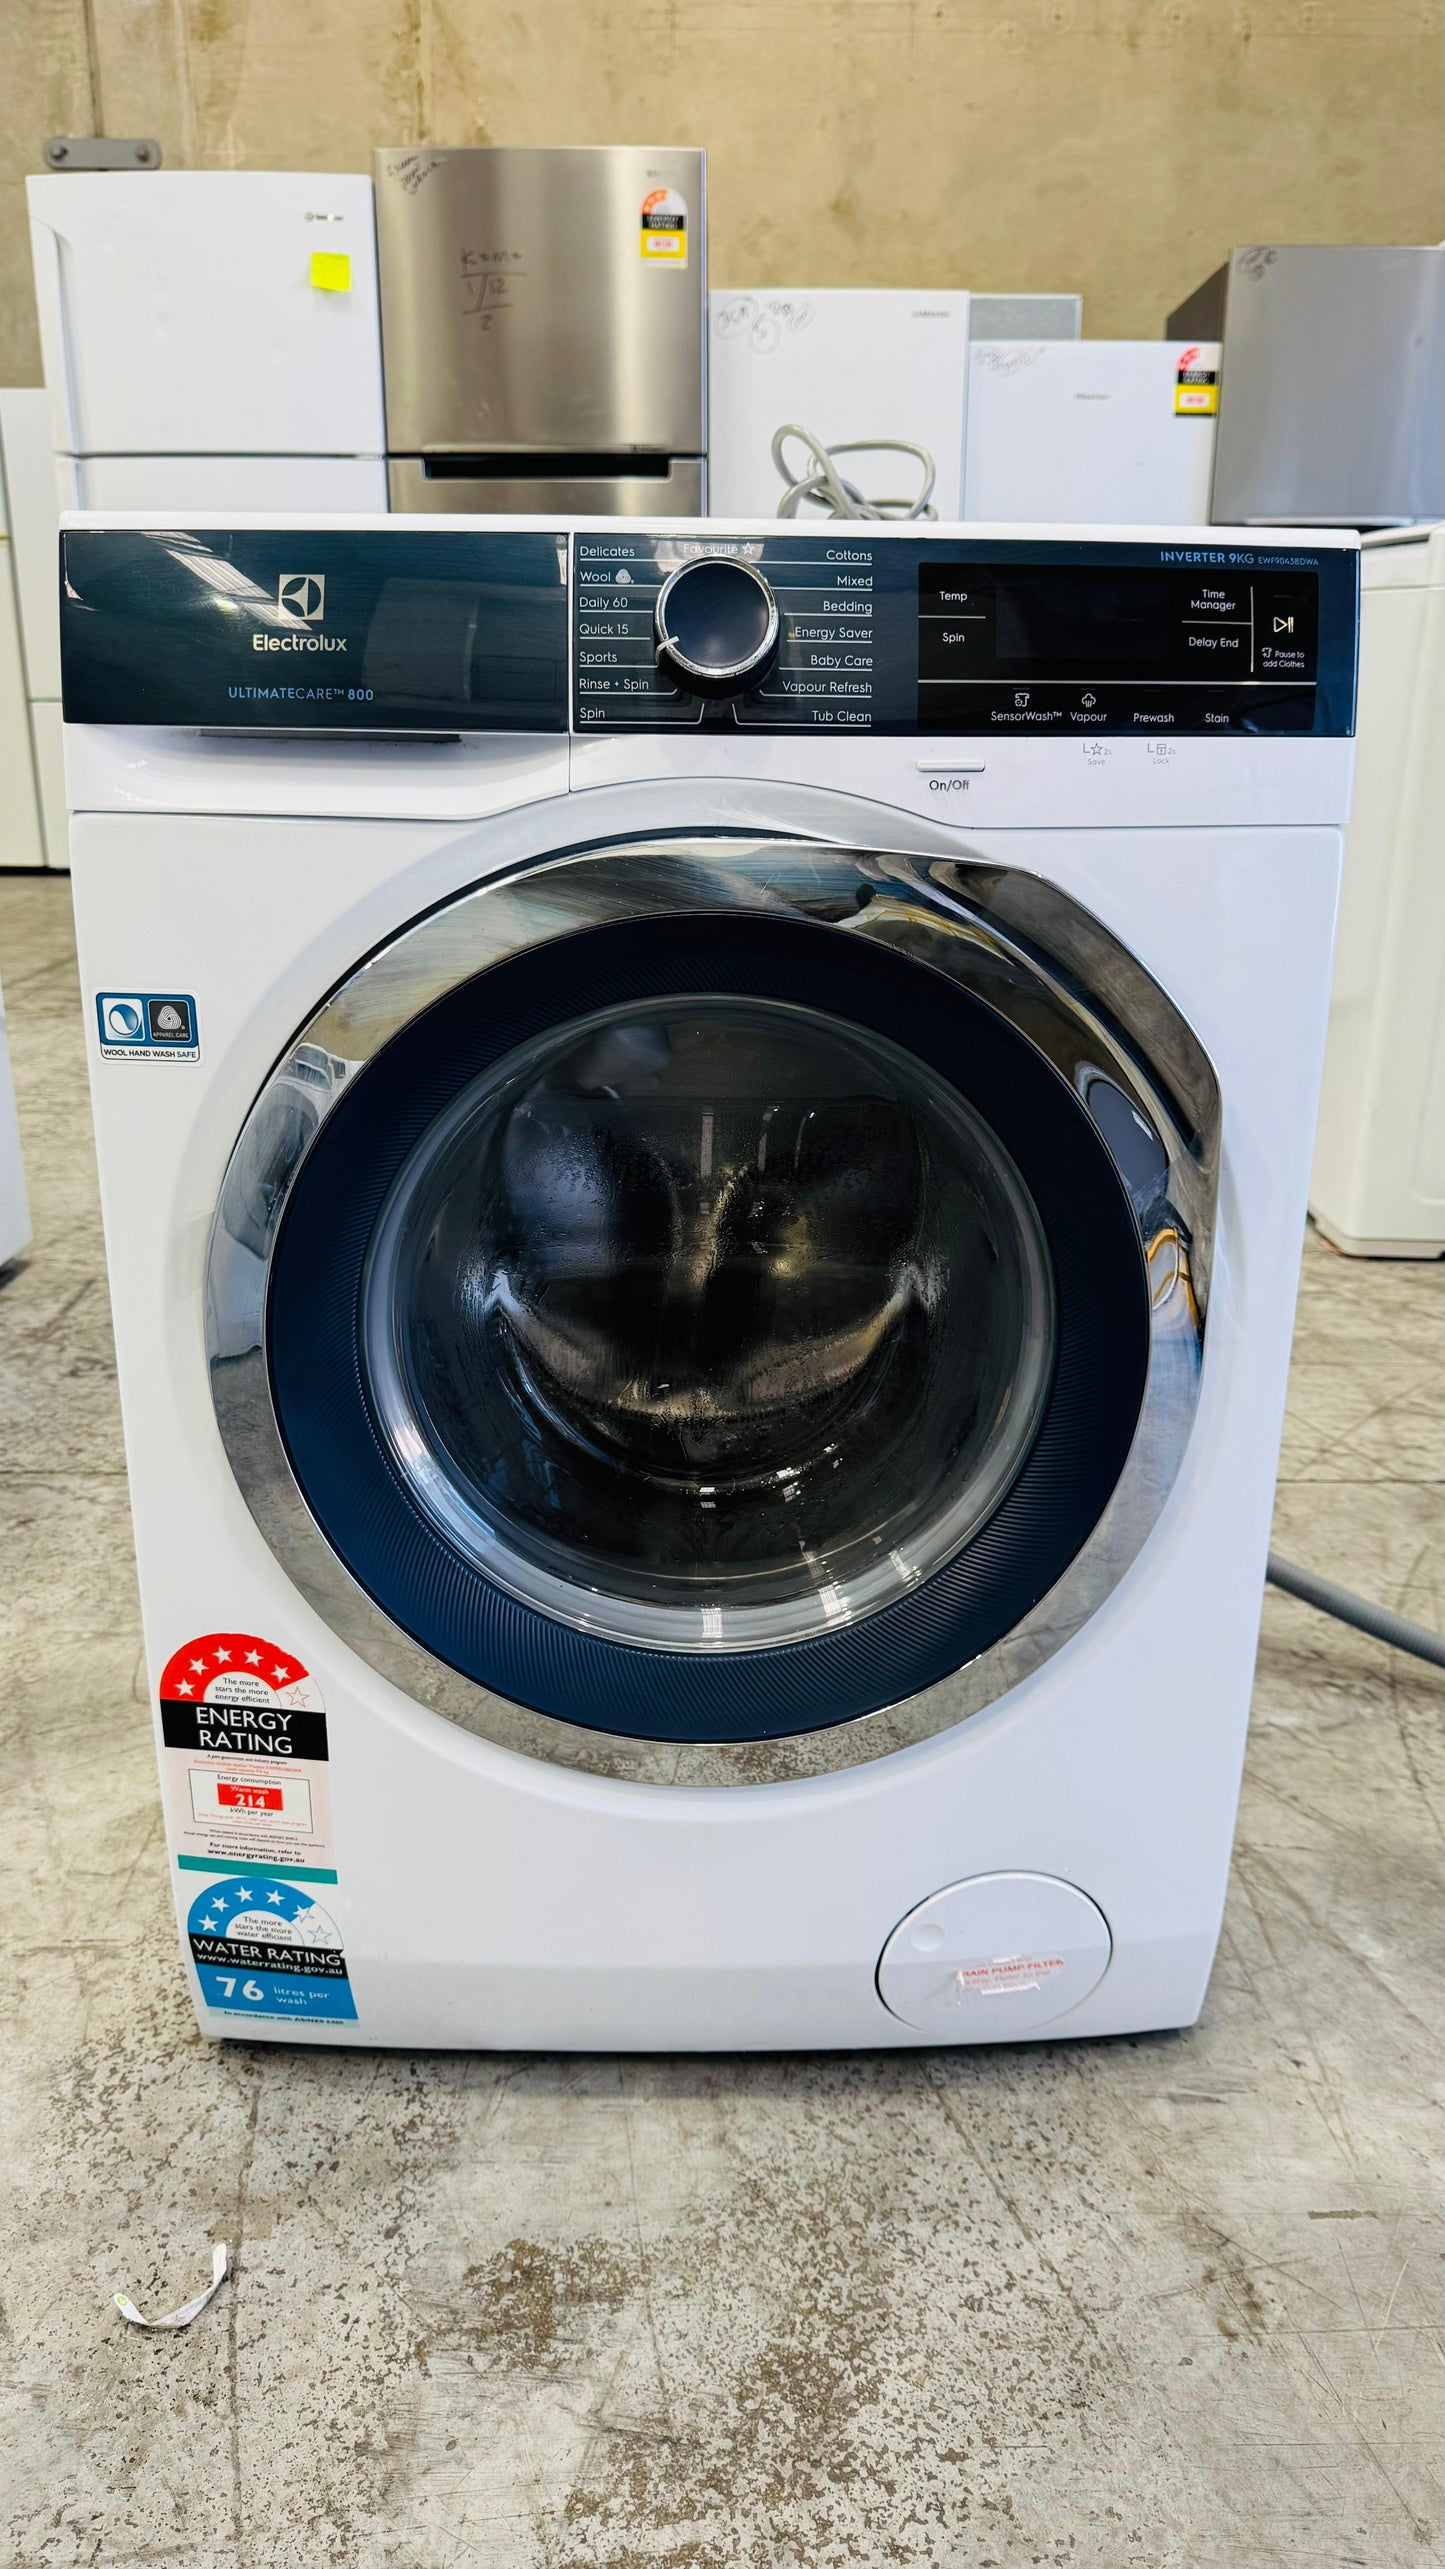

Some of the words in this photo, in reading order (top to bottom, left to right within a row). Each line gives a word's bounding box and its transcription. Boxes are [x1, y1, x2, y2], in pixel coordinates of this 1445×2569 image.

[580, 546, 635, 557] Delicates
[683, 544, 738, 555] Favourite
[826, 550, 873, 562] Cottons
[1160, 551, 1225, 563] INVERTER
[1229, 553, 1254, 564] 9KG
[580, 571, 611, 583] Wool
[837, 576, 873, 587] Mixed
[939, 591, 968, 603] Temp
[1202, 589, 1226, 599] Time
[579, 597, 610, 610] Daily
[613, 597, 628, 608] 60
[823, 600, 873, 614] Bedding
[1190, 600, 1236, 612] Manager
[579, 624, 614, 635] Quick
[617, 624, 629, 635] 15
[795, 627, 836, 641] Energy
[839, 627, 873, 639] Saver
[252, 634, 348, 652] Electrolux
[942, 632, 965, 645] Spin
[1188, 637, 1218, 649] Delay
[1220, 637, 1239, 648] End
[579, 651, 618, 664] Sports
[1274, 651, 1296, 659] Pause
[1296, 651, 1305, 659] to
[811, 655, 841, 669] Baby
[844, 655, 873, 667] Care
[1263, 660, 1277, 668] add
[1279, 660, 1305, 668] Clothes
[579, 679, 611, 690] Rinse
[623, 679, 649, 692] Spin
[783, 681, 827, 694] Vapour
[829, 681, 872, 694] Refresh
[347, 688, 374, 701] 800
[580, 708, 606, 720] Spin
[812, 710, 833, 722] Tub
[837, 711, 872, 723] Clean
[1070, 711, 1108, 723] Vapour
[1133, 713, 1175, 723] Prewash
[1205, 713, 1229, 724] Stain
[1088, 758, 1106, 766] Save
[929, 779, 970, 791] On/Off
[103, 1048, 128, 1056] WOOL
[128, 1049, 151, 1057] HAND
[177, 1050, 197, 1058] SAFE
[223, 1677, 237, 1685] The
[234, 1686, 247, 1694] the
[215, 1694, 240, 1703] energy
[241, 1695, 270, 1704] efficient
[196, 1706, 292, 1731] ENERGY
[199, 1729, 293, 1754] RATING
[217, 1773, 239, 1783] Energy
[240, 1776, 282, 1786] consumption
[230, 1785, 252, 1793] Warm
[235, 1793, 266, 1808] 214
[247, 1808, 258, 1816] per
[207, 1848, 305, 1863] www.energyrating.gov.au
[243, 1916, 258, 1924] The
[260, 1918, 283, 1927] more
[234, 1923, 253, 1931] stars
[256, 1924, 269, 1932] the
[271, 1926, 293, 1935] more
[236, 1930, 259, 1938] water
[261, 1932, 292, 1941] efficient
[192, 1938, 264, 1959] WATER
[267, 1947, 341, 1967] RATING
[196, 1952, 343, 1975] www.waterrating.gov.au
[991, 1964, 1025, 1974] PUMP
[1027, 1958, 1065, 1969] FILTER
[216, 1975, 264, 2001] 76
[273, 1986, 305, 1997] litres
[309, 1991, 330, 2000] per
[276, 1997, 308, 2006] wash
